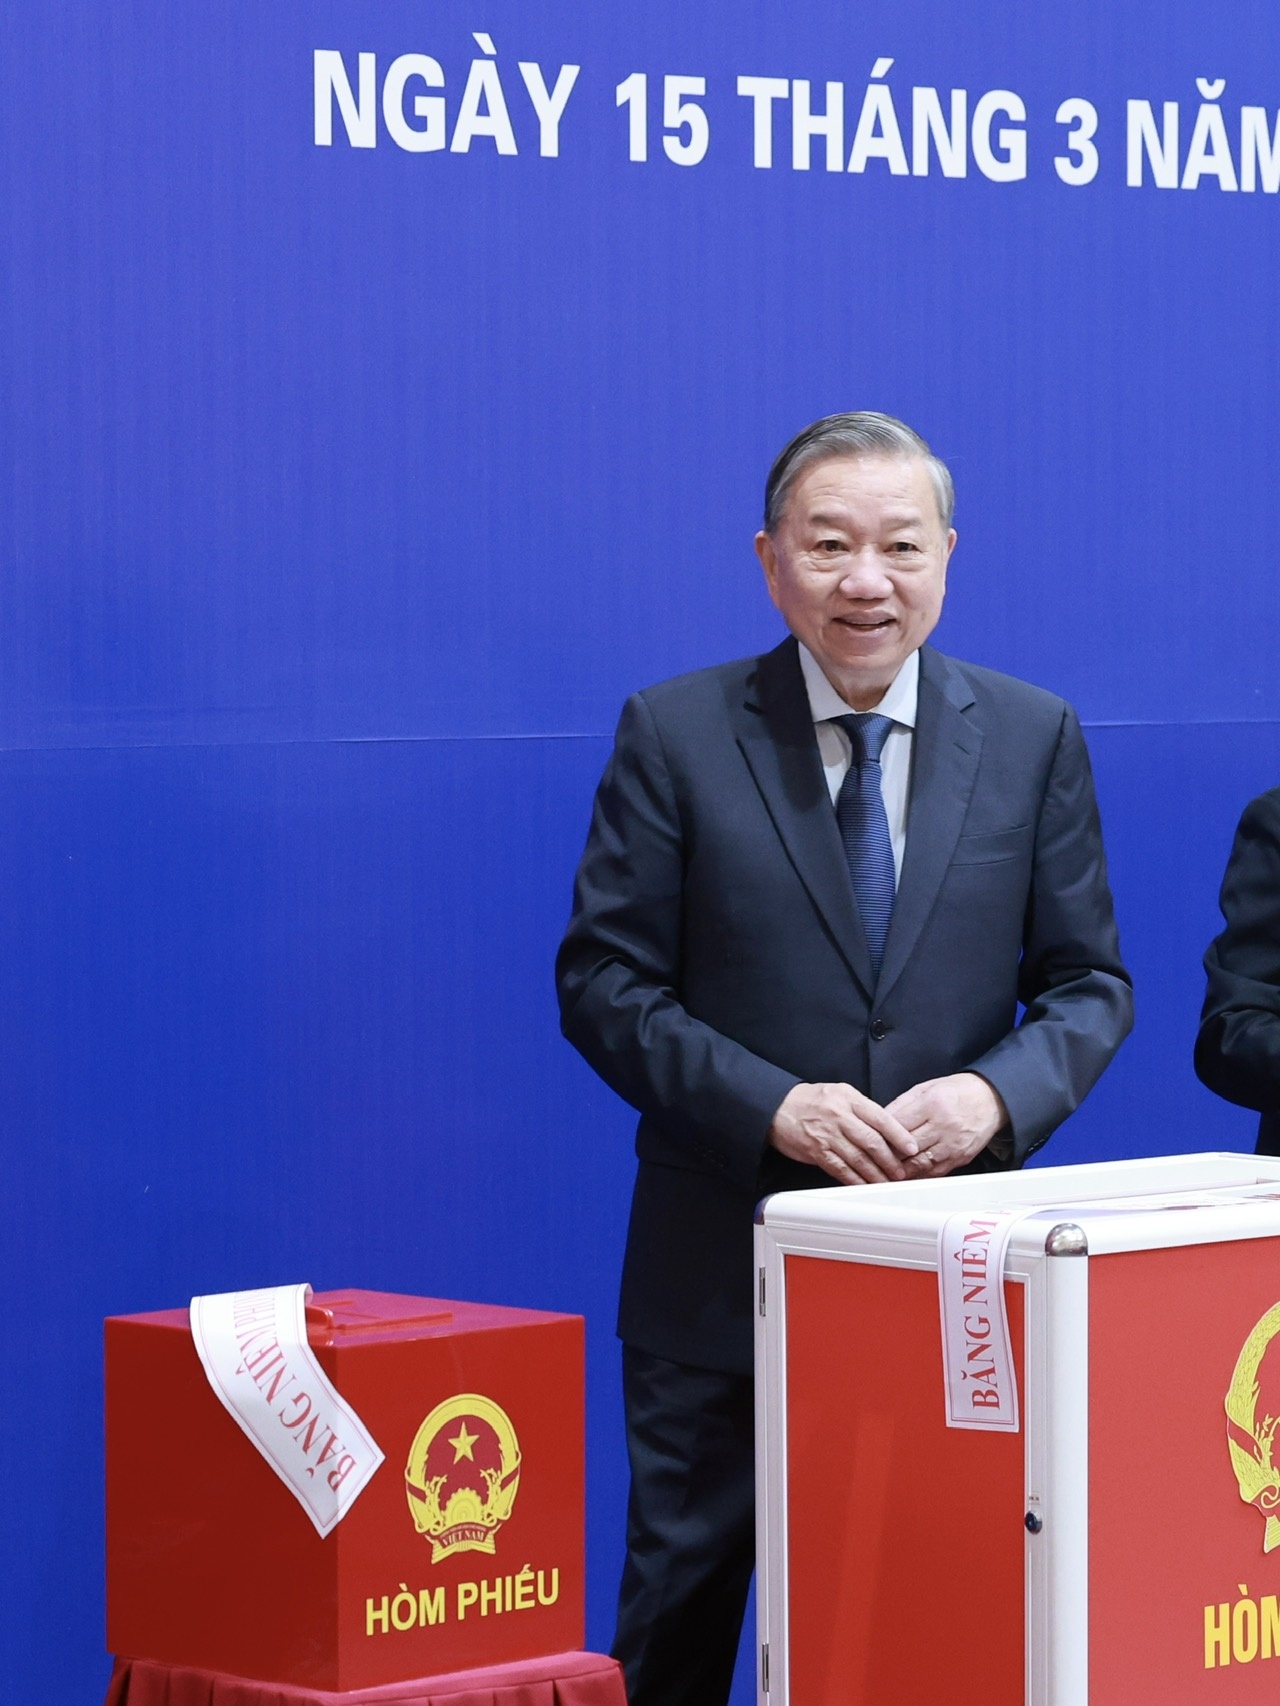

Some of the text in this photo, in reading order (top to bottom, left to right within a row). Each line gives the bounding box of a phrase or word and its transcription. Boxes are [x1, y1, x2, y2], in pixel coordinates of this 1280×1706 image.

[313, 32, 581, 158] NGÀY
[616, 72, 709, 167] 15
[736, 57, 1027, 183] THÁNG
[1054, 97, 1099, 186] 3
[954, 1219, 999, 1304] NIÊM
[961, 1314, 1001, 1410] BĂNG
[278, 1391, 358, 1494] BĂNG
[366, 1563, 560, 1636] HÒM PHIẾU
